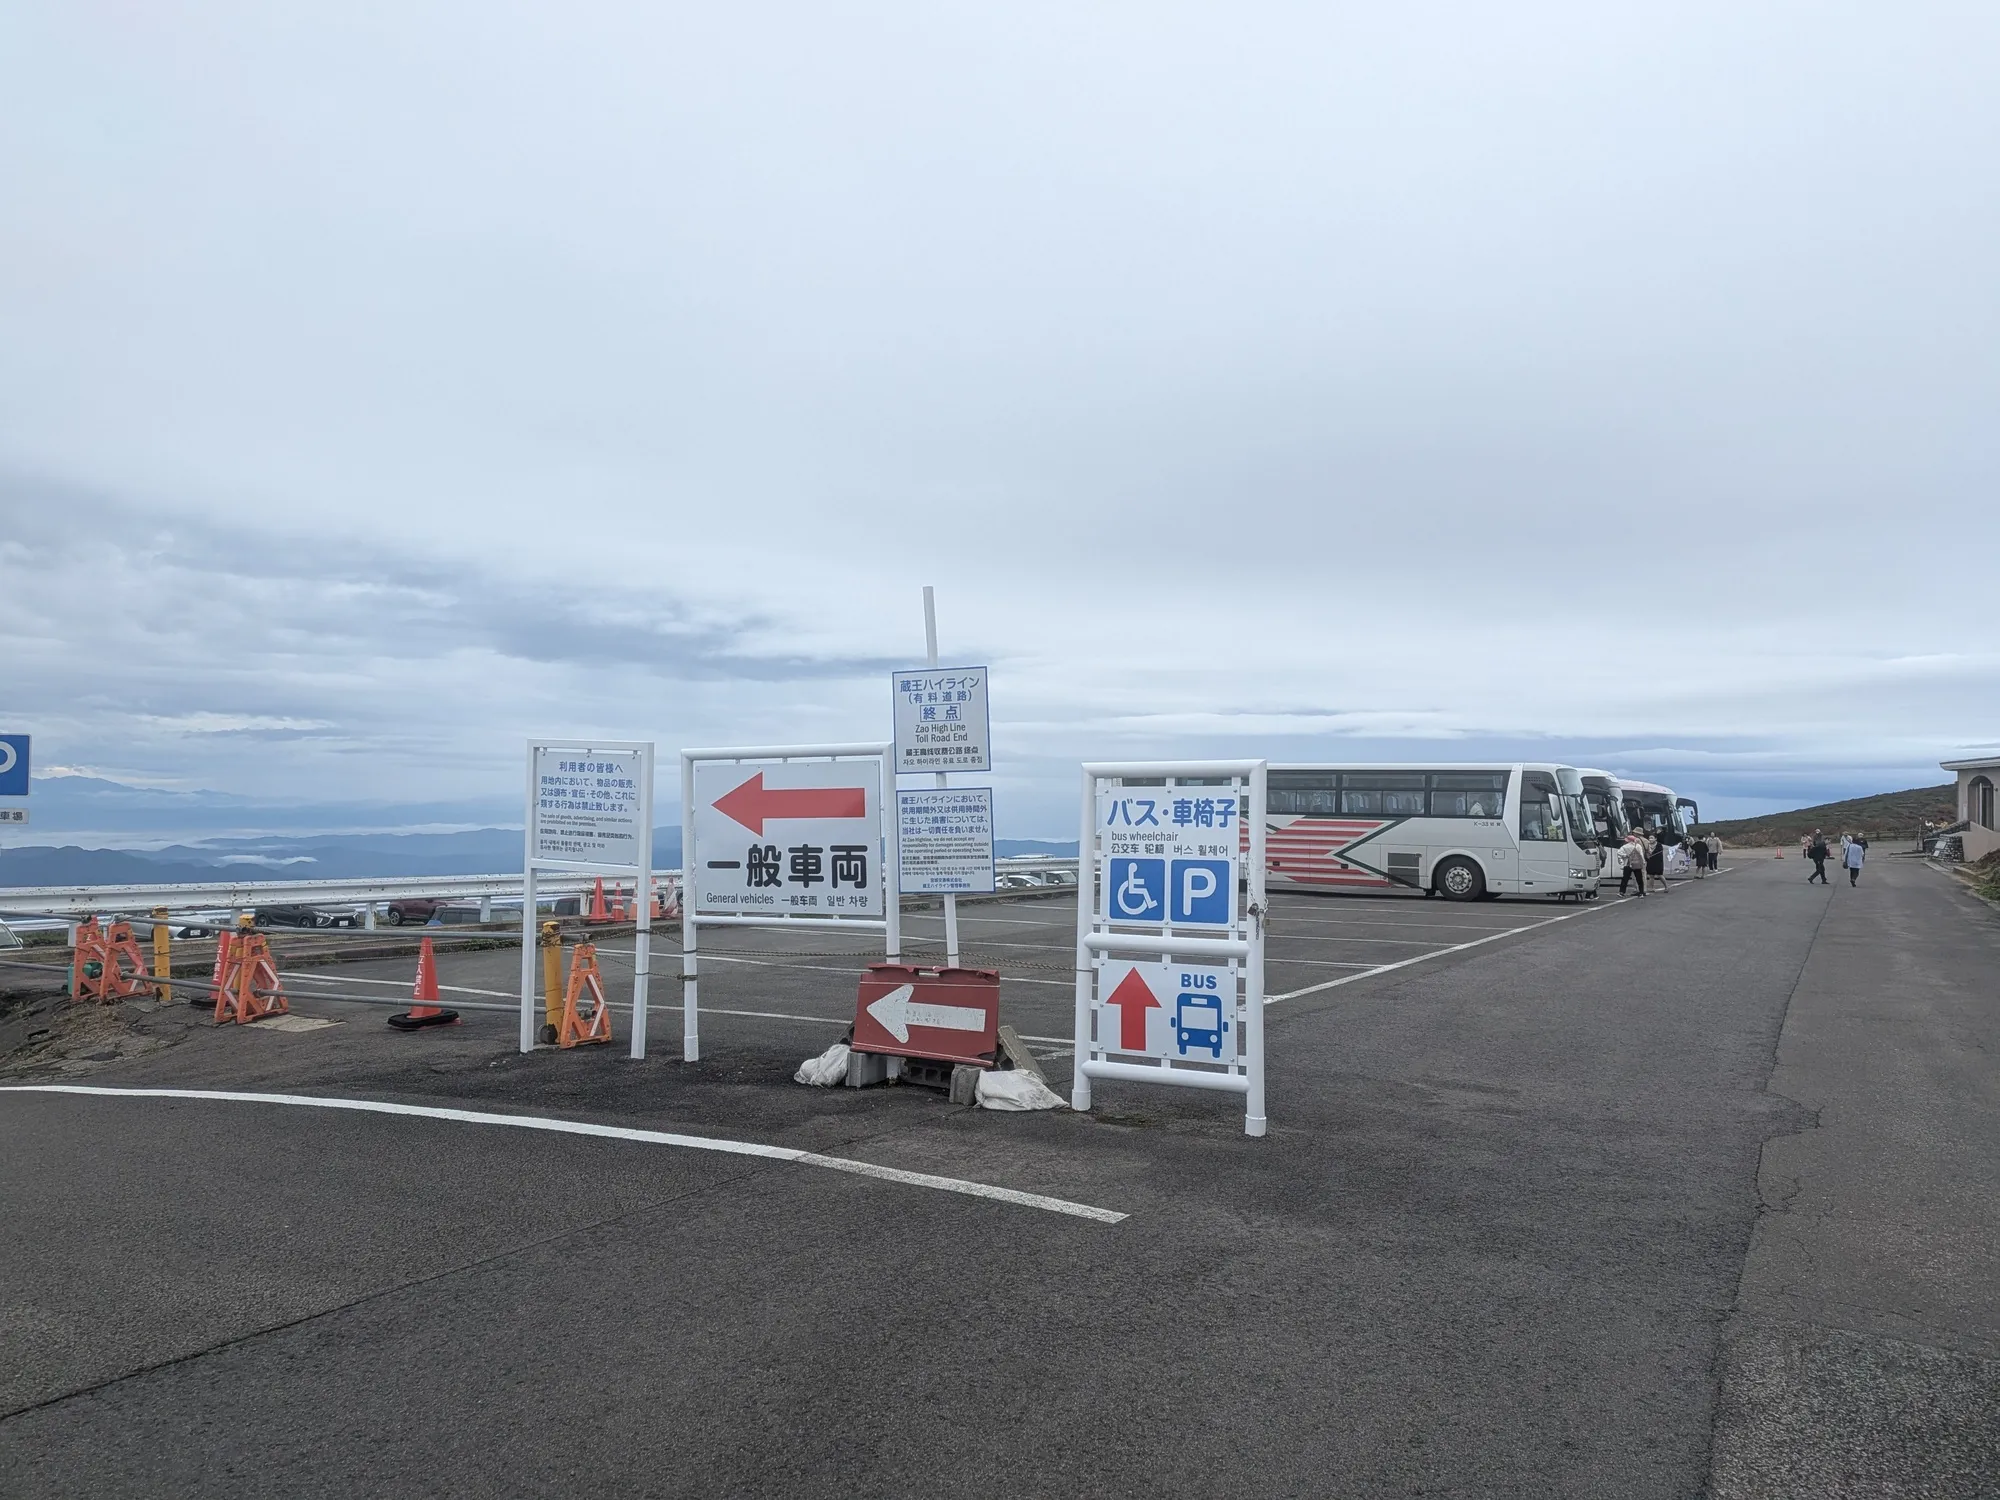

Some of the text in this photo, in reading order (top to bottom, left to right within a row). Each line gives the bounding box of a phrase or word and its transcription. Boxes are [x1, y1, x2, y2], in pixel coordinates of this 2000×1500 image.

[900, 676, 980, 693] 蔵王ハイライン
[923, 705, 958, 720] 終点
[915, 722, 966, 734] Zao High Line
[915, 732, 968, 743] Toll Road End
[559, 761, 624, 774] 利用者の皆様へ
[902, 815, 988, 824] に生じた損害については、
[1107, 798, 1237, 828] バス・車椅子
[1111, 831, 1179, 842] bus wheelchair
[1111, 843, 1140, 854] 公交车
[1173, 844, 1193, 856] 버스
[707, 844, 868, 889] 一般車両
[706, 892, 774, 905] General vehicles
[1183, 868, 1217, 916] P
[826, 895, 868, 907] 일반 차량
[1181, 973, 1217, 989] BUS
